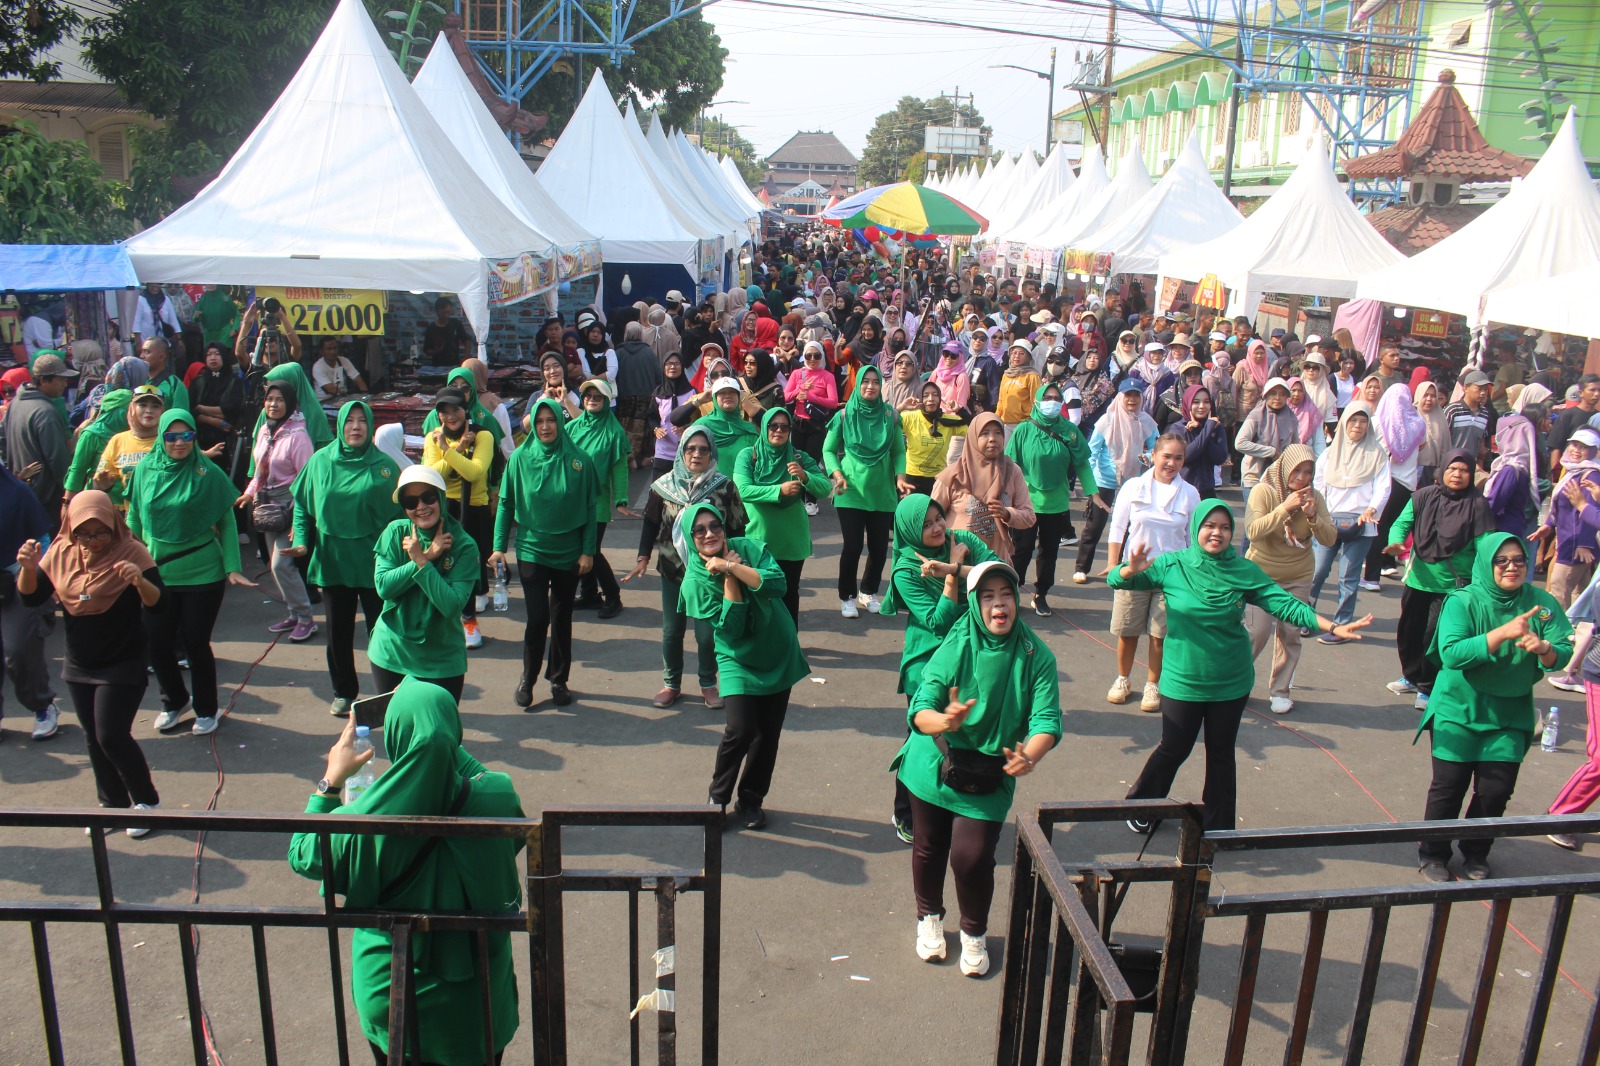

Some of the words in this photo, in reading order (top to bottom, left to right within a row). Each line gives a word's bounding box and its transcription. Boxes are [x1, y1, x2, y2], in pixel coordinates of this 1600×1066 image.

[285, 287, 321, 300] OBRAL
[290, 303, 381, 332] 27.000
[1415, 322, 1445, 335] 125.000
